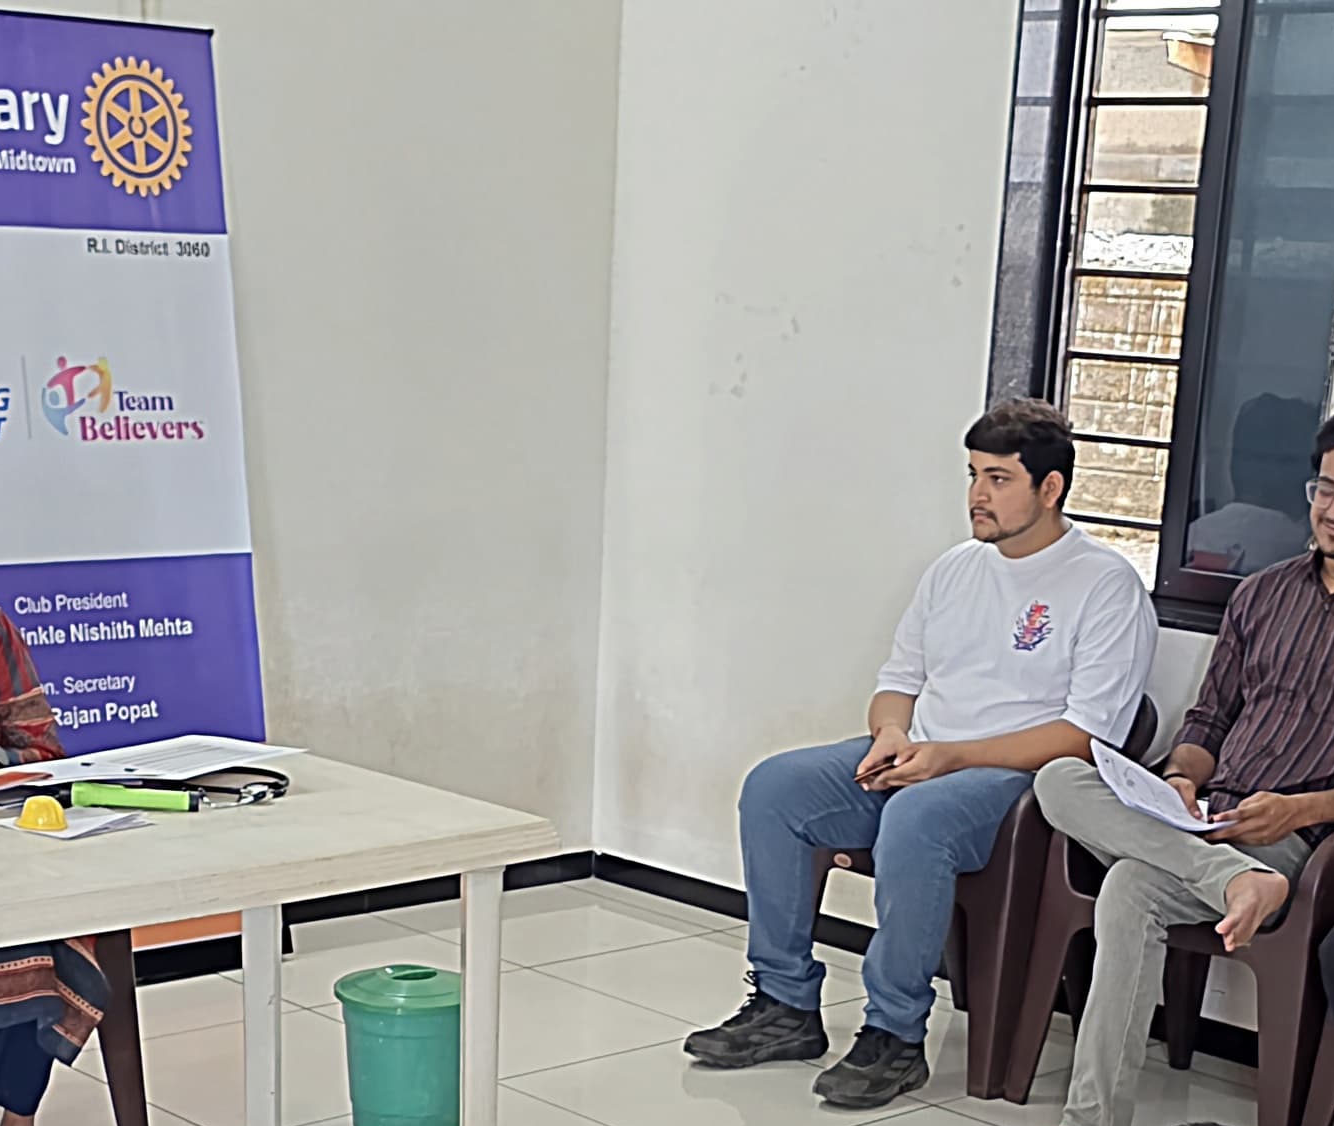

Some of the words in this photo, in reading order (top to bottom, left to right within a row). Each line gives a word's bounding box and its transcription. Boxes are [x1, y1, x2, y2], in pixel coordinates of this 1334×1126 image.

[115, 238, 169, 256] District
[176, 241, 210, 257] 3060
[114, 390, 174, 412] Team
[80, 415, 204, 442] Believers
[14, 596, 52, 615] Club
[55, 592, 129, 612] President
[70, 621, 134, 643] Nishith
[139, 618, 193, 638] Mehta
[64, 676, 135, 694] Secretary
[51, 707, 101, 729] Rajan
[106, 700, 159, 723] Popat
